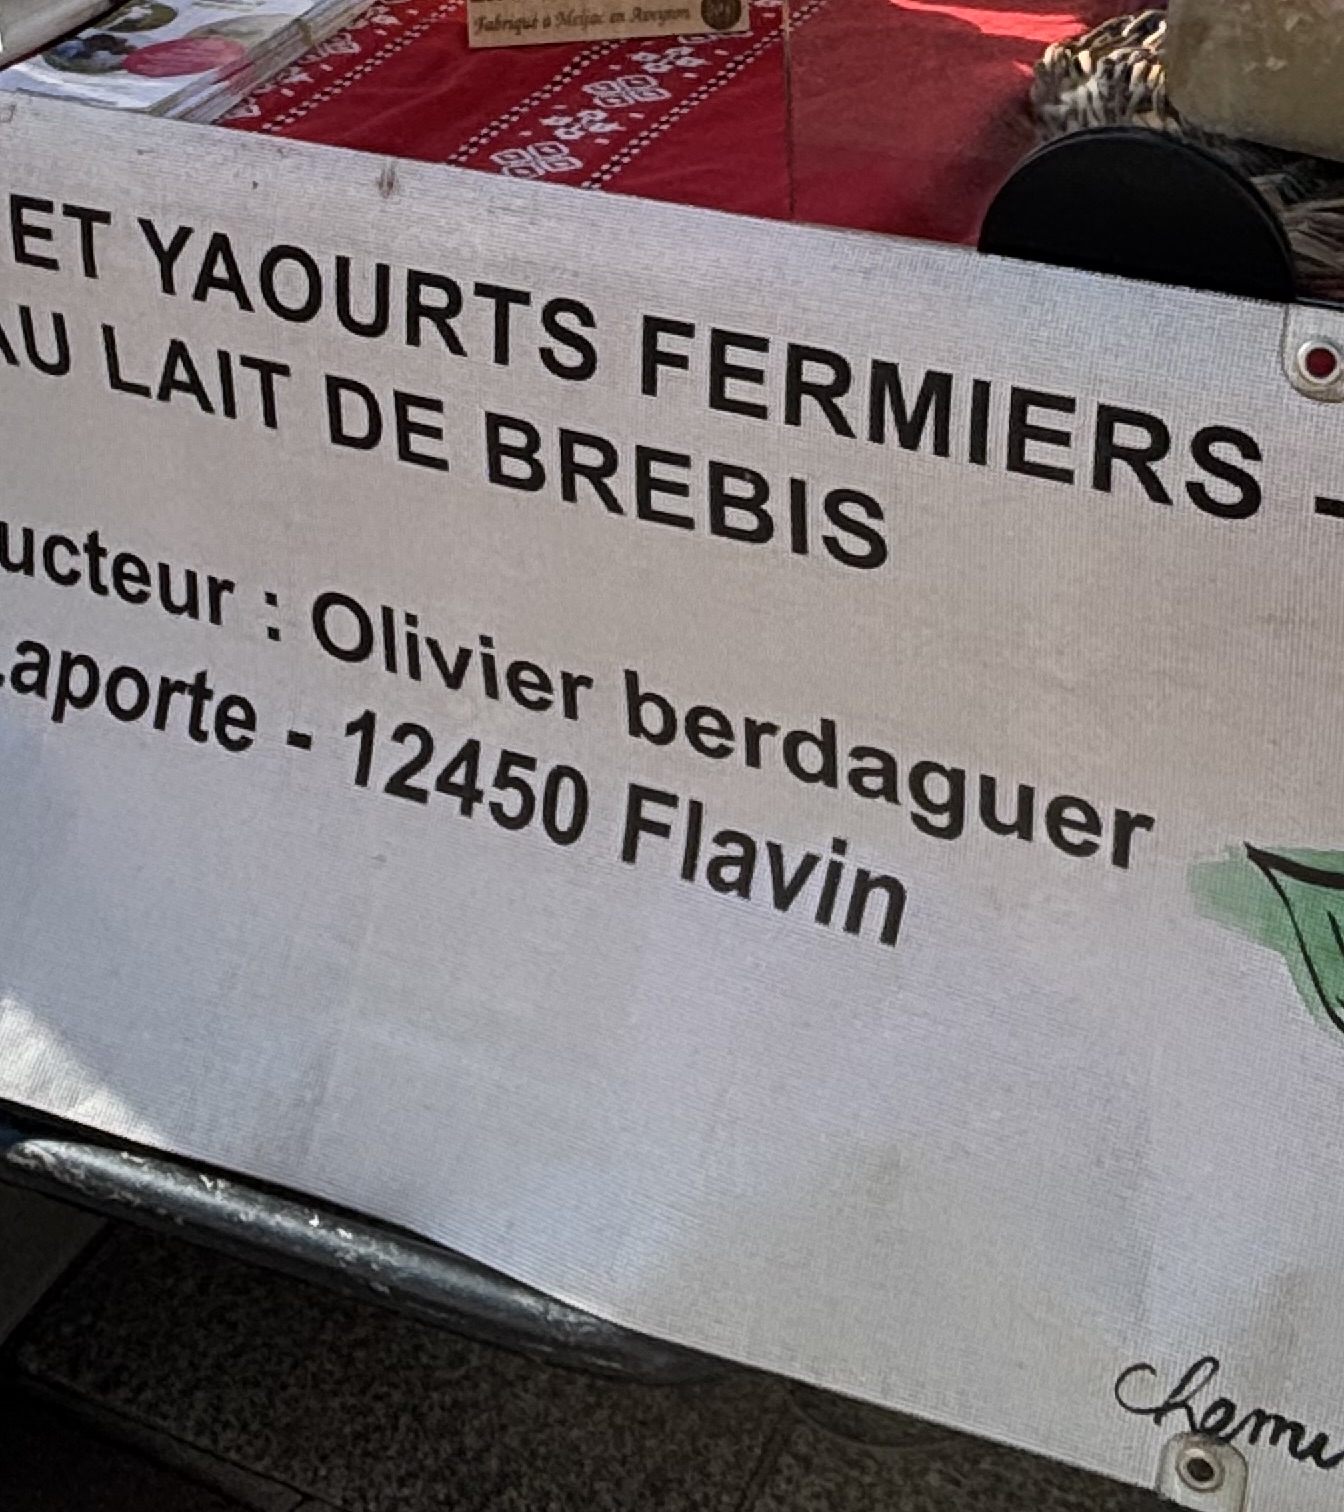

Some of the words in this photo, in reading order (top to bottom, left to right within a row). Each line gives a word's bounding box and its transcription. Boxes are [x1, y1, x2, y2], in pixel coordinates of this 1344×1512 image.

[9, 194, 112, 279] ET
[137, 216, 599, 381] YAOURTS
[641, 314, 1264, 520] FERMIERS
[100, 322, 292, 430] LAIT
[324, 373, 451, 472] DE
[484, 409, 889, 571] BREBIS
[264, 591, 282, 643] :
[311, 591, 594, 721] Olivier
[623, 668, 1156, 870] berdaguer
[286, 729, 313, 751] -
[344, 709, 590, 846] 12450
[620, 782, 908, 949] Flavin
